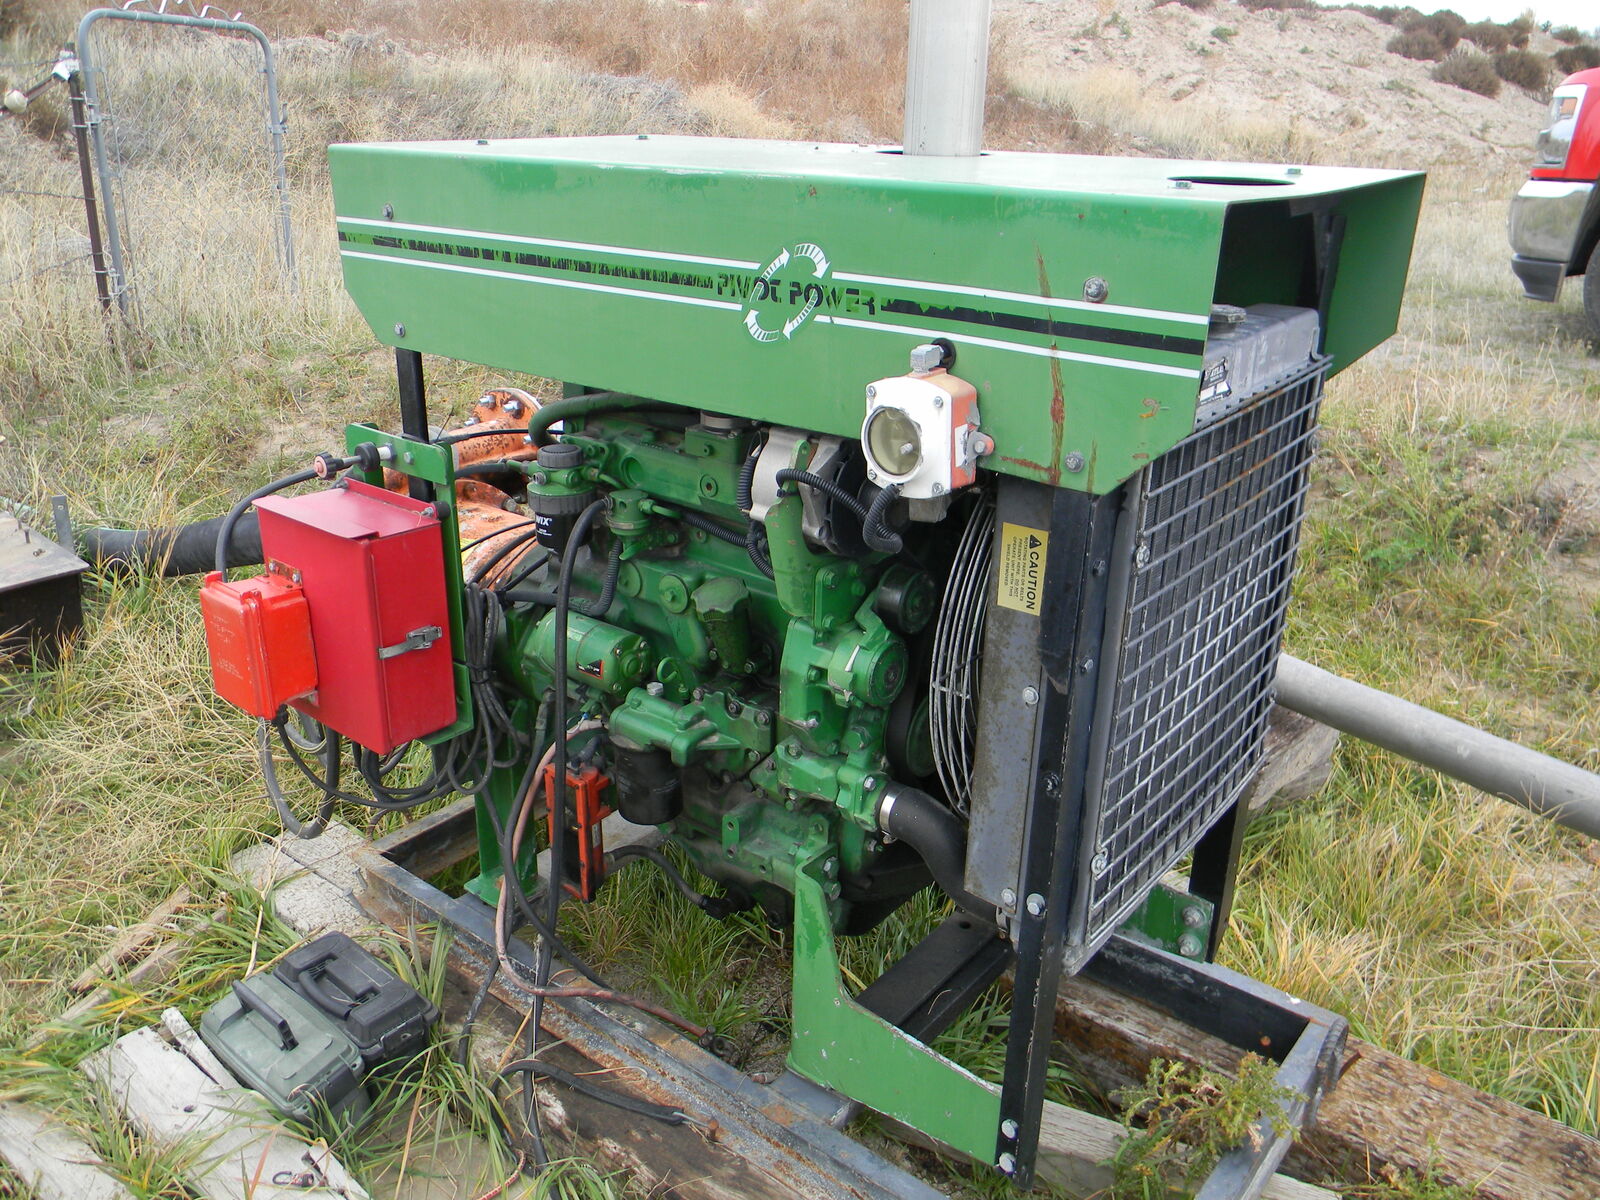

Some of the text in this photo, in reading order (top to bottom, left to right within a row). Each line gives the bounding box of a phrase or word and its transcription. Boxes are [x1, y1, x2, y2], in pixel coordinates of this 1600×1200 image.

[717, 272, 876, 315] PIVOT POWER
[1026, 552, 1039, 610] CAUTION
